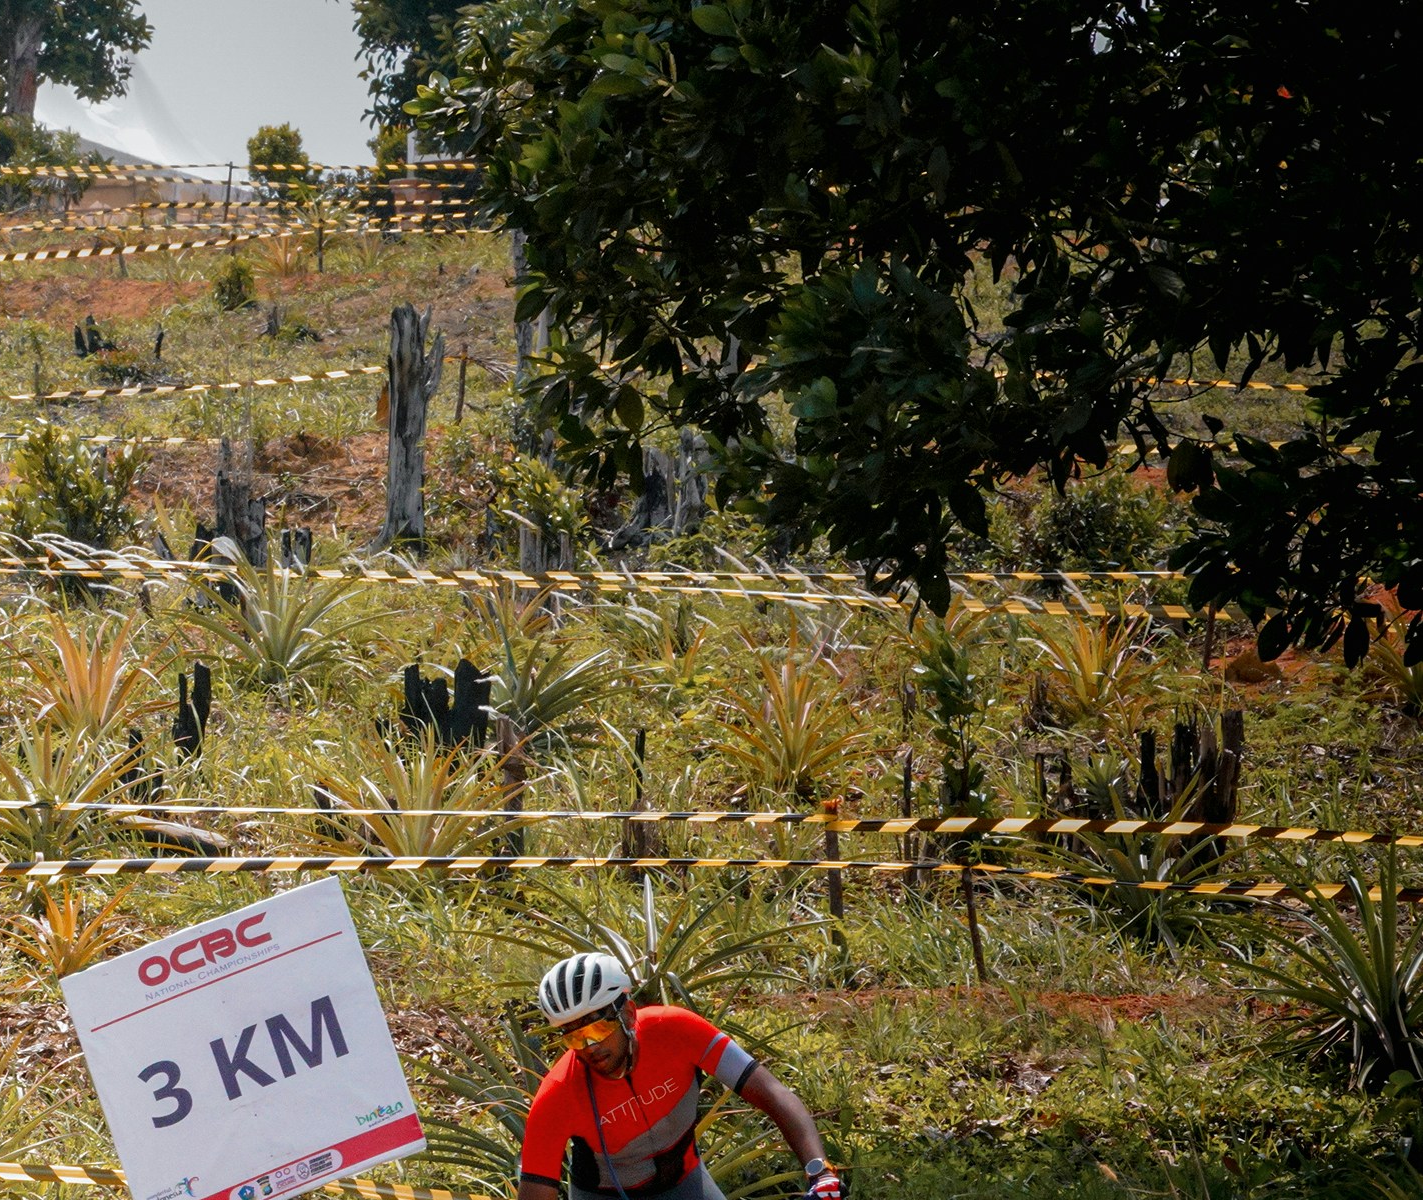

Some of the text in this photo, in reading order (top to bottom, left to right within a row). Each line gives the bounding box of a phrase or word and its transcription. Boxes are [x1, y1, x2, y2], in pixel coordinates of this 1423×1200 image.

[138, 911, 273, 986] OCBC
[145, 943, 281, 1001] NATIONAL CHAMPIONSHIPS
[137, 995, 350, 1129] 3 KM
[600, 1077, 679, 1125] ATTITUDE
